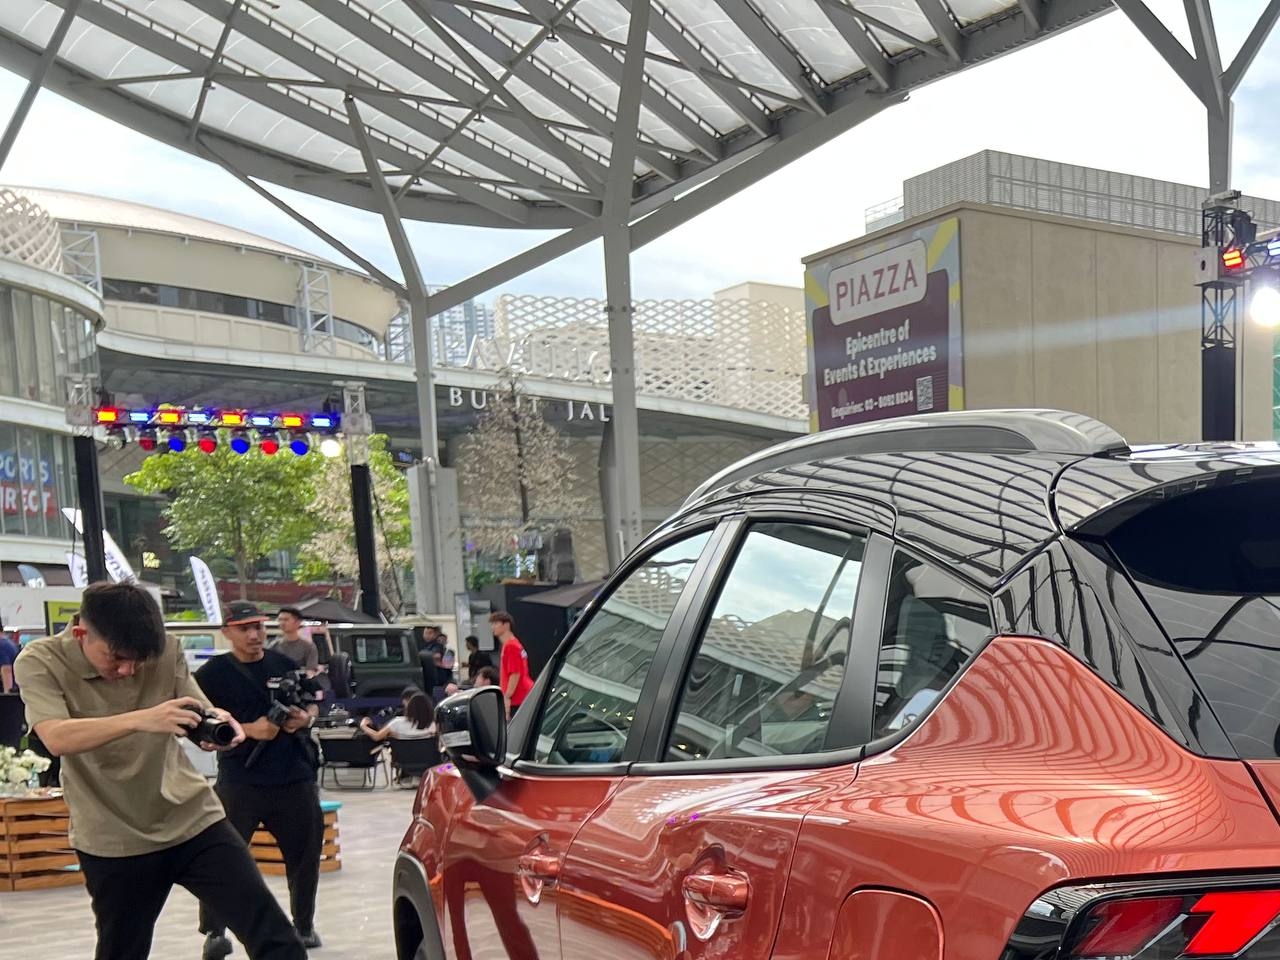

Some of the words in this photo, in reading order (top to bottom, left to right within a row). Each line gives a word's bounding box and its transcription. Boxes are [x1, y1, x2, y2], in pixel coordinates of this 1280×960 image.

[836, 259, 918, 311] PIAZZA
[846, 328, 896, 360] Epicentre
[898, 319, 910, 341] of
[824, 363, 858, 387] Events
[859, 359, 867, 378] &
[867, 345, 937, 379] Experiences
[450, 386, 542, 413] BUIT
